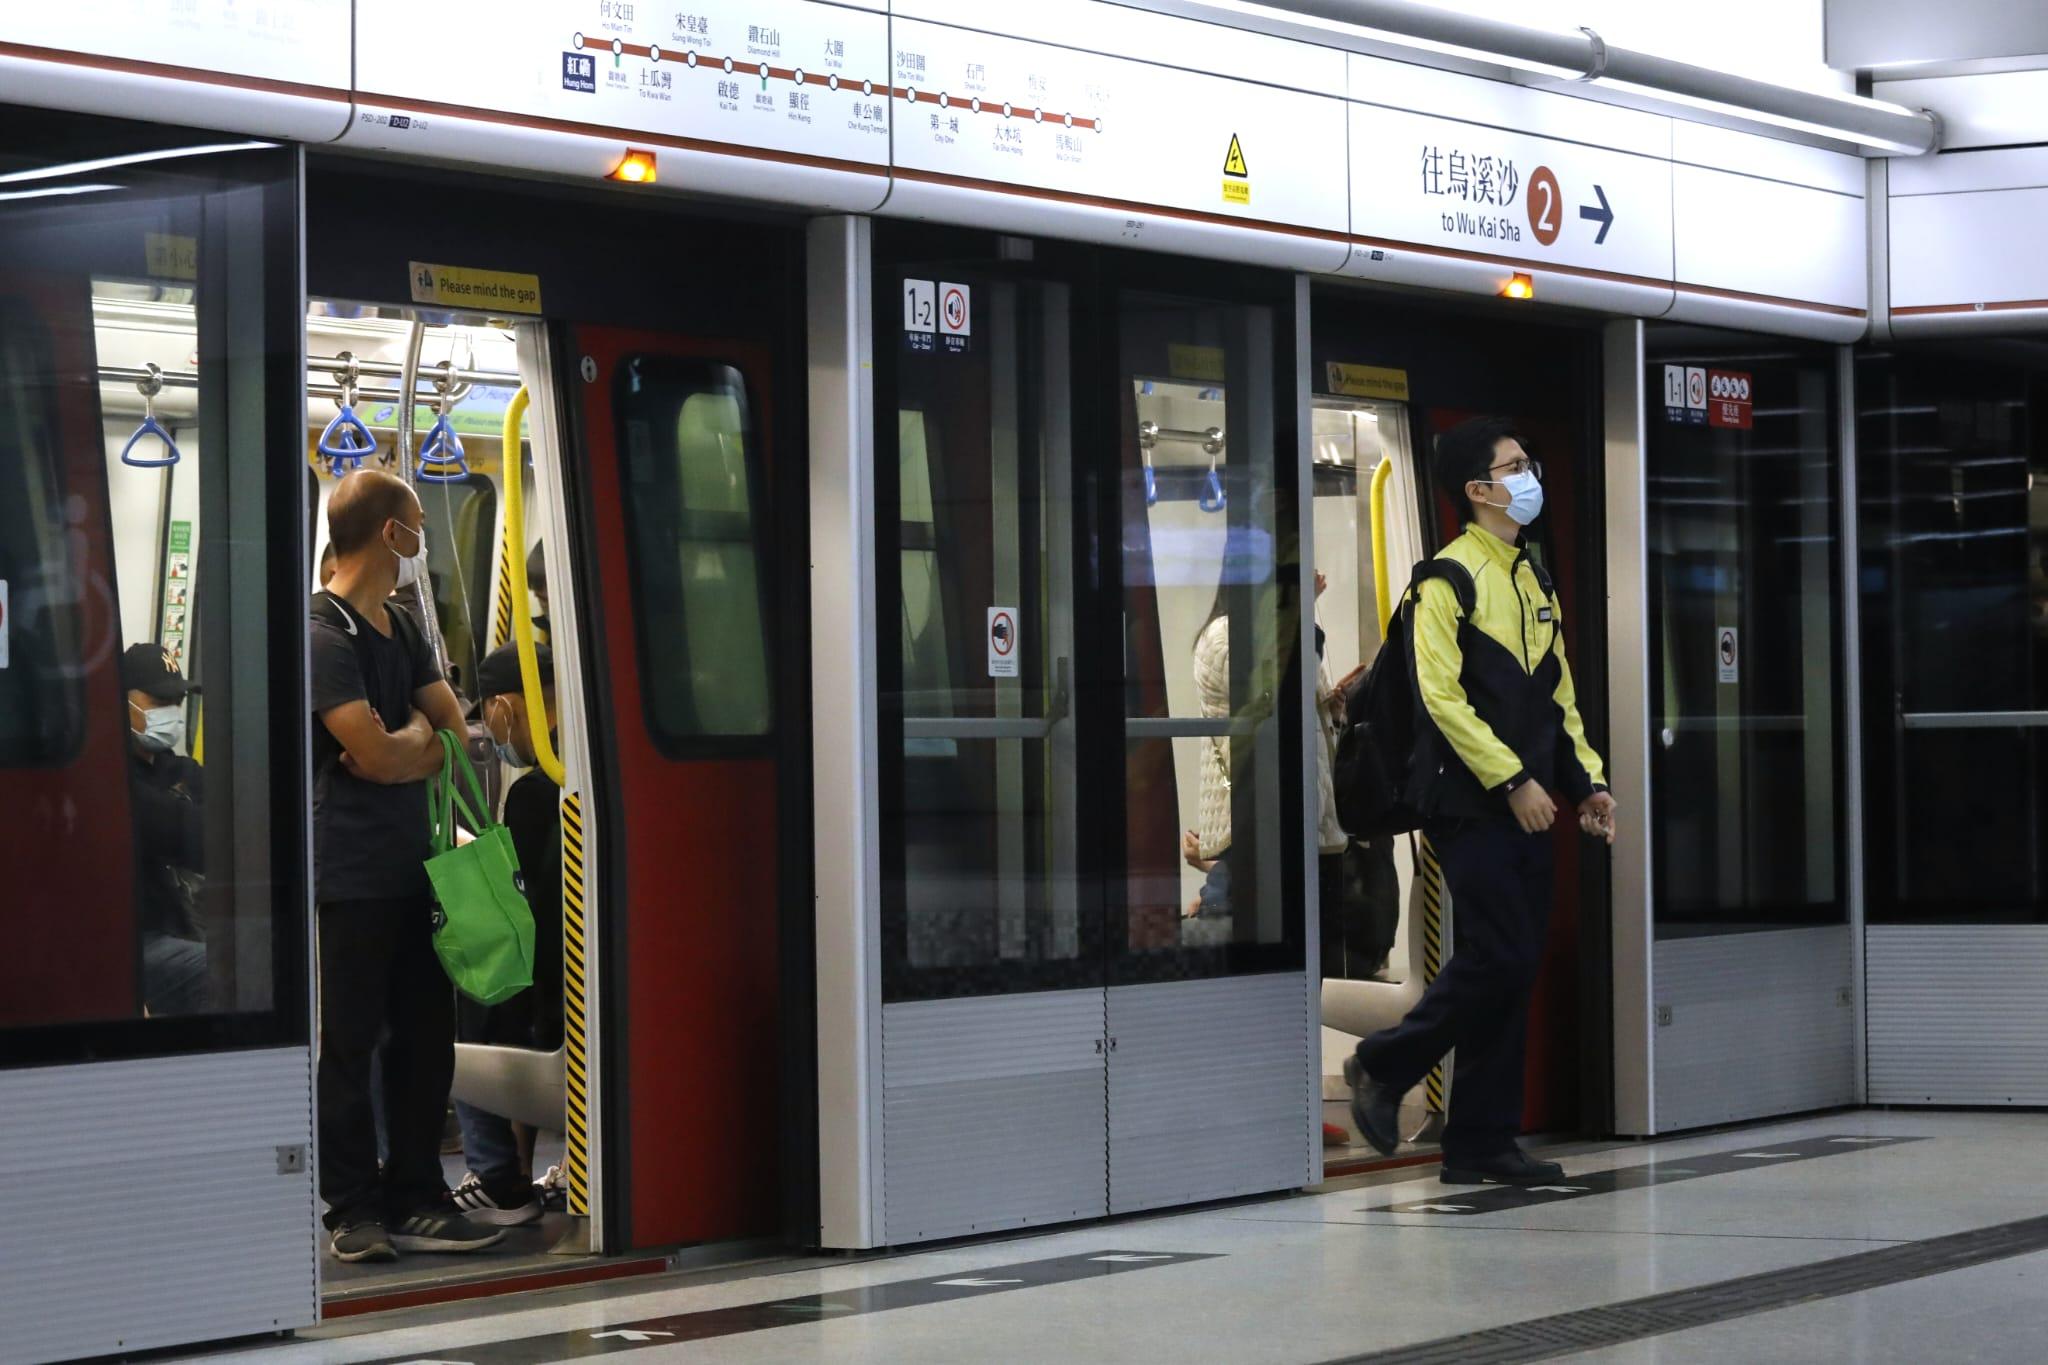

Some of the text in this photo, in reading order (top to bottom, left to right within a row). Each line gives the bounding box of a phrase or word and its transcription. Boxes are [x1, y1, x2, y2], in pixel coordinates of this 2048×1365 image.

[601, 0, 633, 22] 何文田
[672, 32, 686, 44] Sung
[687, 35, 702, 47] Wong
[748, 24, 780, 47] 鑽石山
[747, 45, 781, 58] Diamond Hill
[824, 38, 844, 57] 大圍
[639, 67, 672, 90] 土瓜灣
[966, 63, 985, 81] 石門
[563, 77, 580, 91] Hung
[580, 80, 594, 90] Hom
[639, 89, 647, 98] To
[659, 92, 672, 102] Wan
[728, 102, 738, 112] Tak
[853, 101, 883, 122] 車公廟
[798, 114, 811, 125] Keng
[848, 120, 888, 135] Che Kung Temple
[994, 124, 1022, 144] 大水坑
[1421, 145, 1519, 207] 往烏溪沙
[1537, 180, 1553, 232] 2
[1442, 211, 1520, 242] to Wu Kai Sha
[440, 277, 536, 304] Please mind the gap
[908, 288, 931, 327] 1-2
